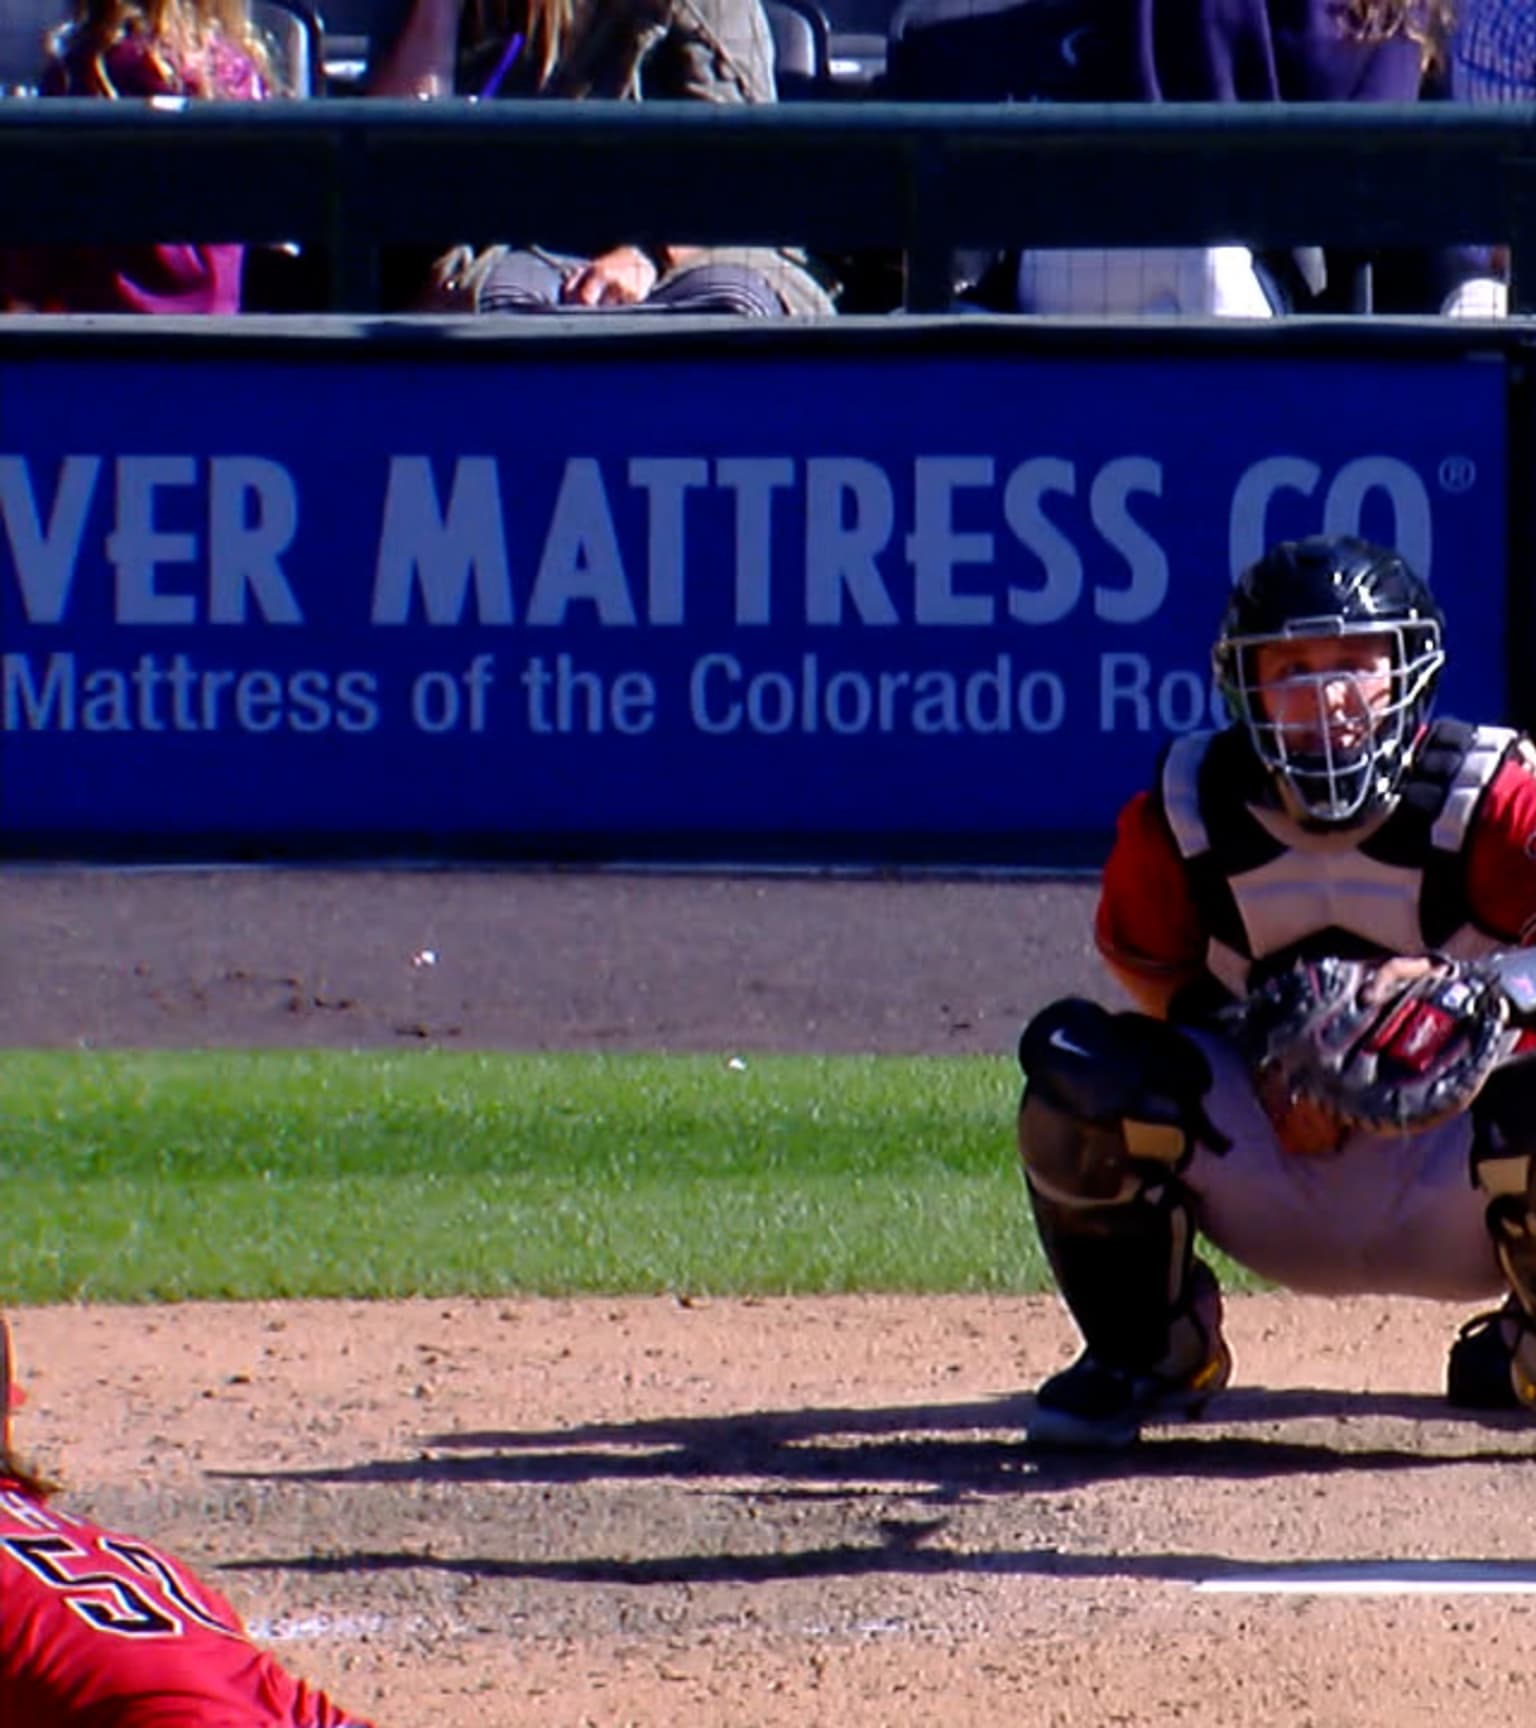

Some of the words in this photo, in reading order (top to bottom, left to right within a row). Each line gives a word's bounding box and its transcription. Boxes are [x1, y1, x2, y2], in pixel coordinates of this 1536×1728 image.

[0, 455, 302, 625] VER
[370, 455, 1169, 625] MATTRESS
[2, 652, 379, 732] Mattress
[412, 653, 494, 733] of
[521, 653, 656, 733] the
[689, 652, 1065, 734] Colorado
